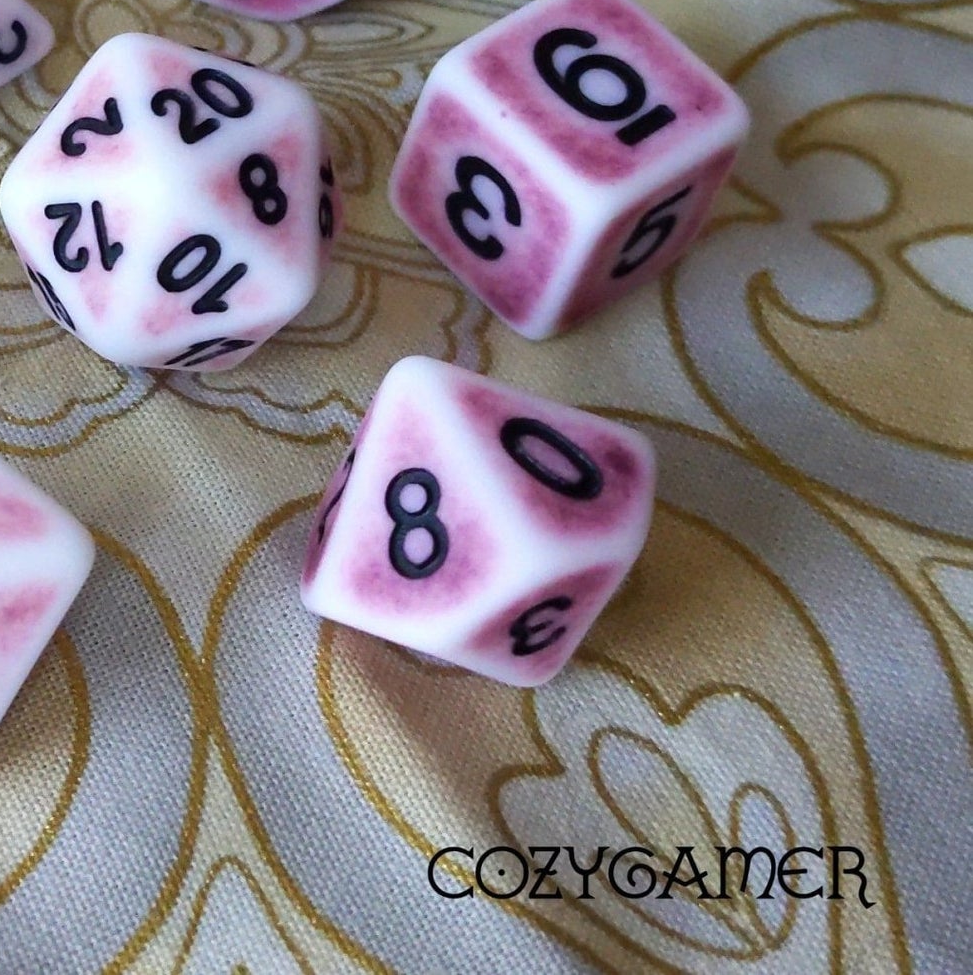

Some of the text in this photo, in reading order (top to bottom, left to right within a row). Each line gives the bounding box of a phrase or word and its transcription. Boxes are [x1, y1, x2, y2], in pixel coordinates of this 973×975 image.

[60, 97, 124, 158] 2
[150, 67, 255, 145] 20
[533, 27, 677, 146] 6
[234, 151, 290, 229] 8
[444, 155, 522, 261] 3
[44, 200, 124, 273] 12
[609, 185, 693, 280] 5
[156, 233, 248, 316] 10
[500, 417, 604, 501] 0
[384, 467, 450, 581] 8
[509, 596, 573, 657] 3
